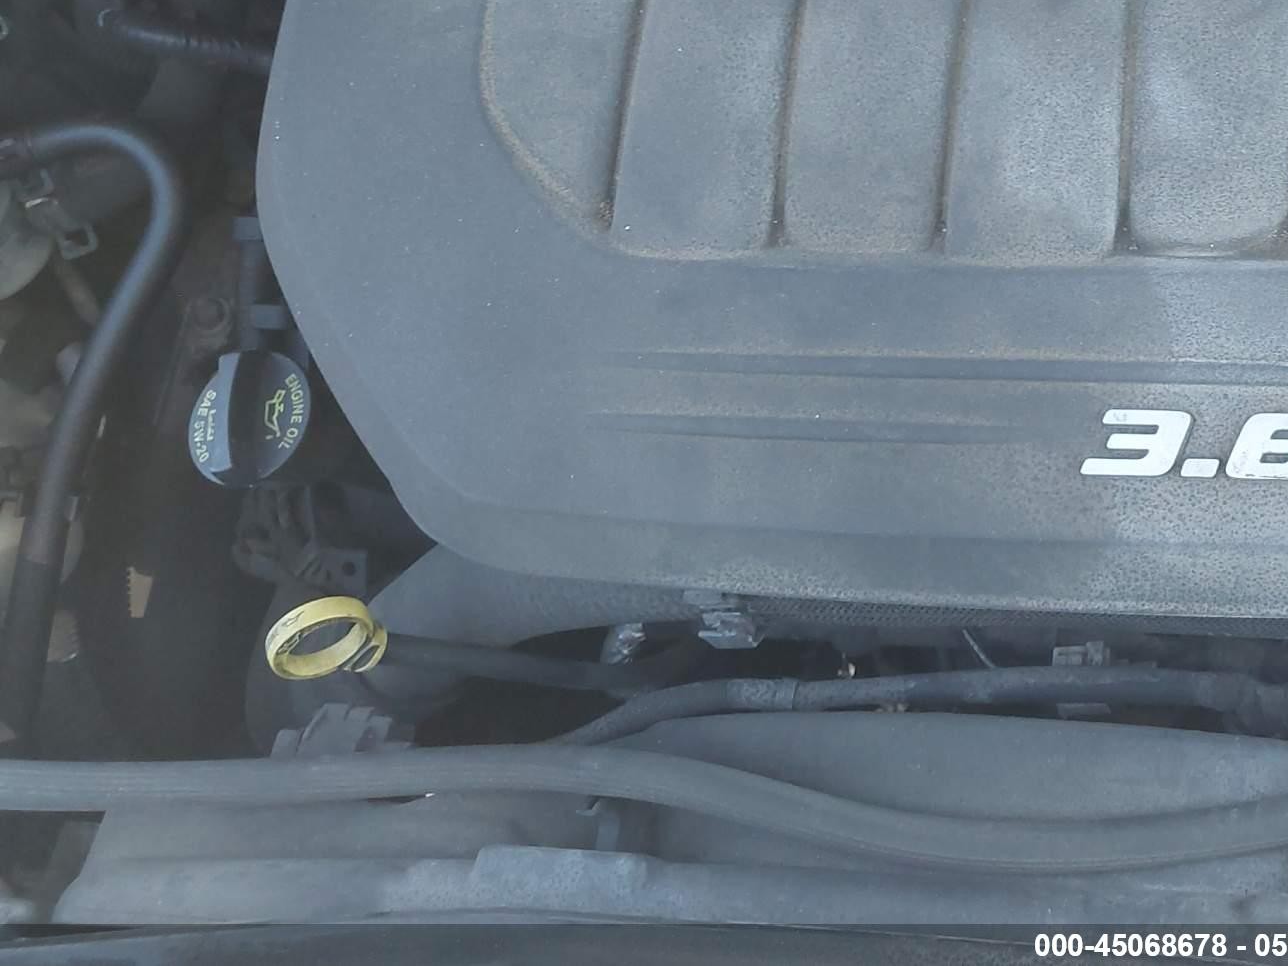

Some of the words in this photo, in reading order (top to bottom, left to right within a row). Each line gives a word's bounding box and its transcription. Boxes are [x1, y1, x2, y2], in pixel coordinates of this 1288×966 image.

[197, 389, 216, 416] SAE
[285, 373, 304, 423] ENGINE
[193, 420, 210, 463] 5W-20
[278, 427, 299, 449] OIL
